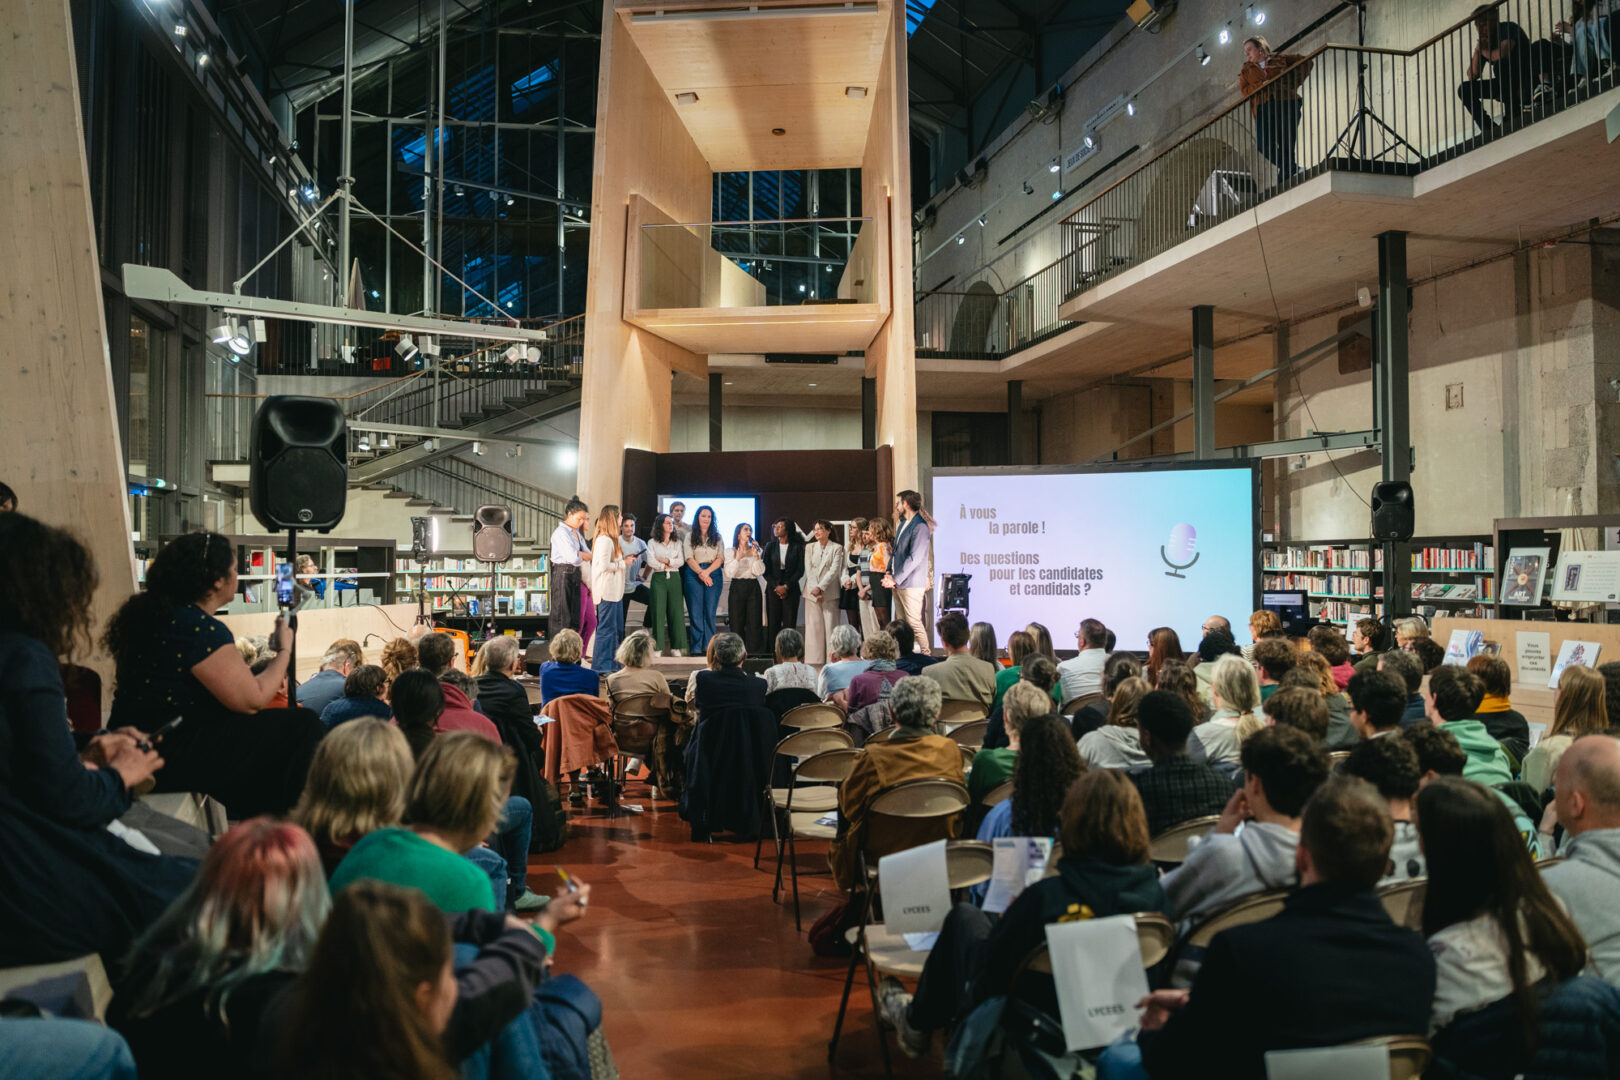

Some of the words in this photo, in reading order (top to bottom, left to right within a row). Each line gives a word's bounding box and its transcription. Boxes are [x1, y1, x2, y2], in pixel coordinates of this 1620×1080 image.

[960, 503, 967, 519] À
[969, 507, 997, 519] vous
[989, 521, 999, 534] la
[1002, 521, 1039, 536] parole
[960, 552, 981, 565] Des
[983, 551, 1040, 566] questions
[990, 568, 1016, 581] pour
[1018, 567, 1036, 580] les
[1039, 566, 1104, 580] candidates
[1009, 582, 1021, 595] et
[1024, 582, 1081, 596] candidats
[1083, 582, 1092, 596] ?
